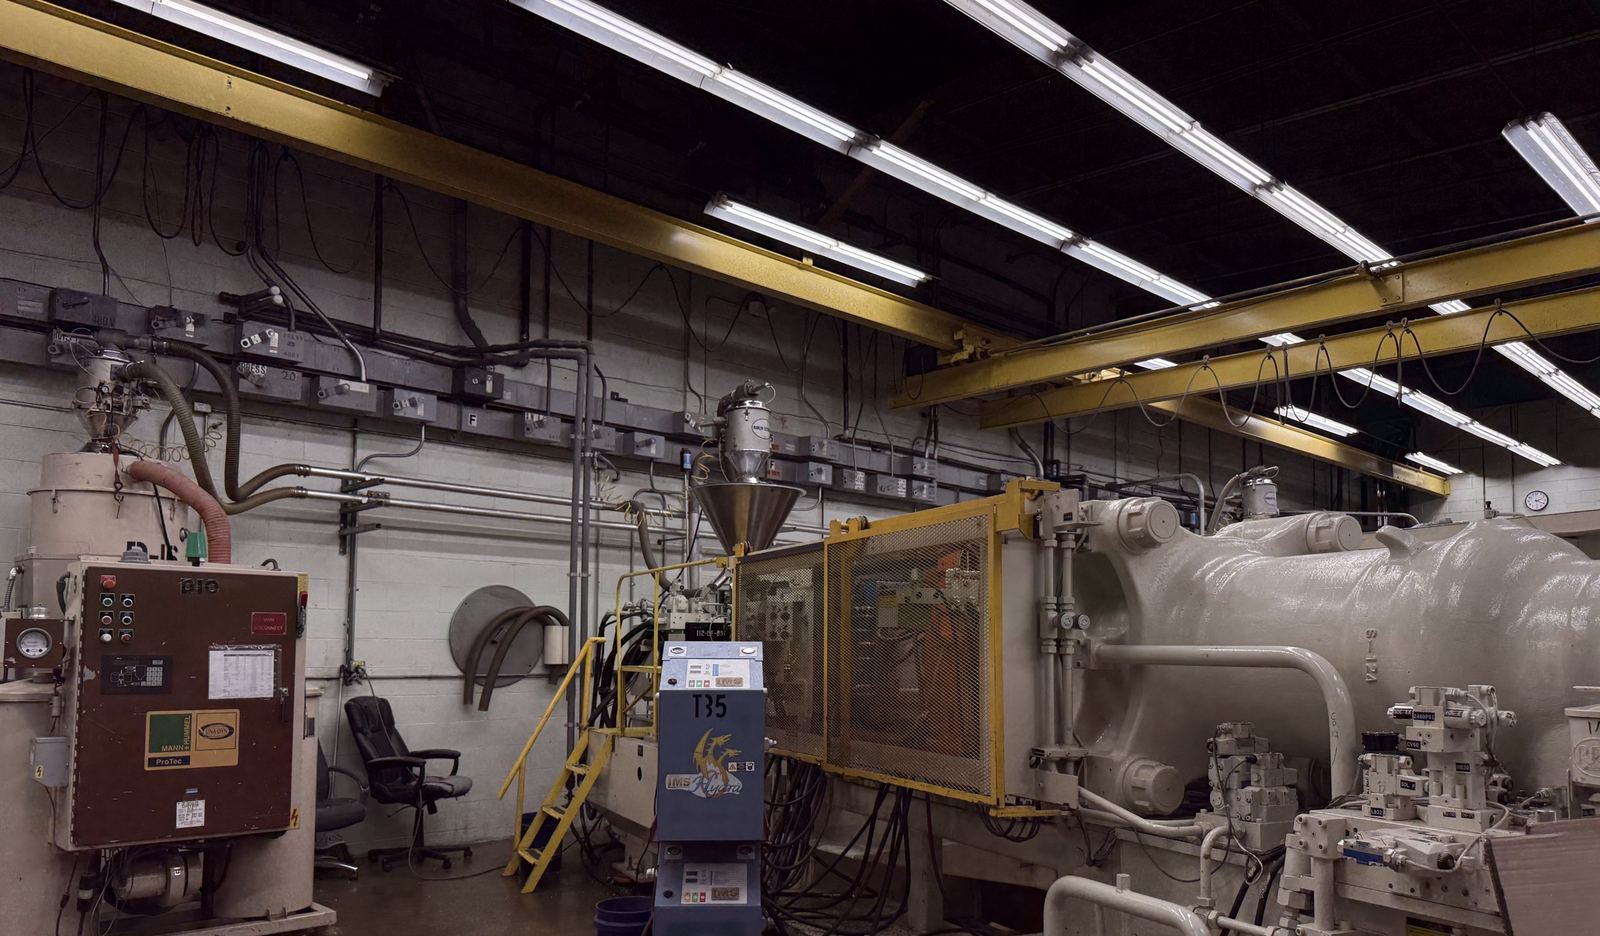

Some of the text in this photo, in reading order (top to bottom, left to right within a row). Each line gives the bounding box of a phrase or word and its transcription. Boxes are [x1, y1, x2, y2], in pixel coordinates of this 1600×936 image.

[282, 370, 298, 382] 20
[469, 414, 477, 425] F
[156, 758, 183, 766] ProTec
[668, 778, 690, 789] IMS
